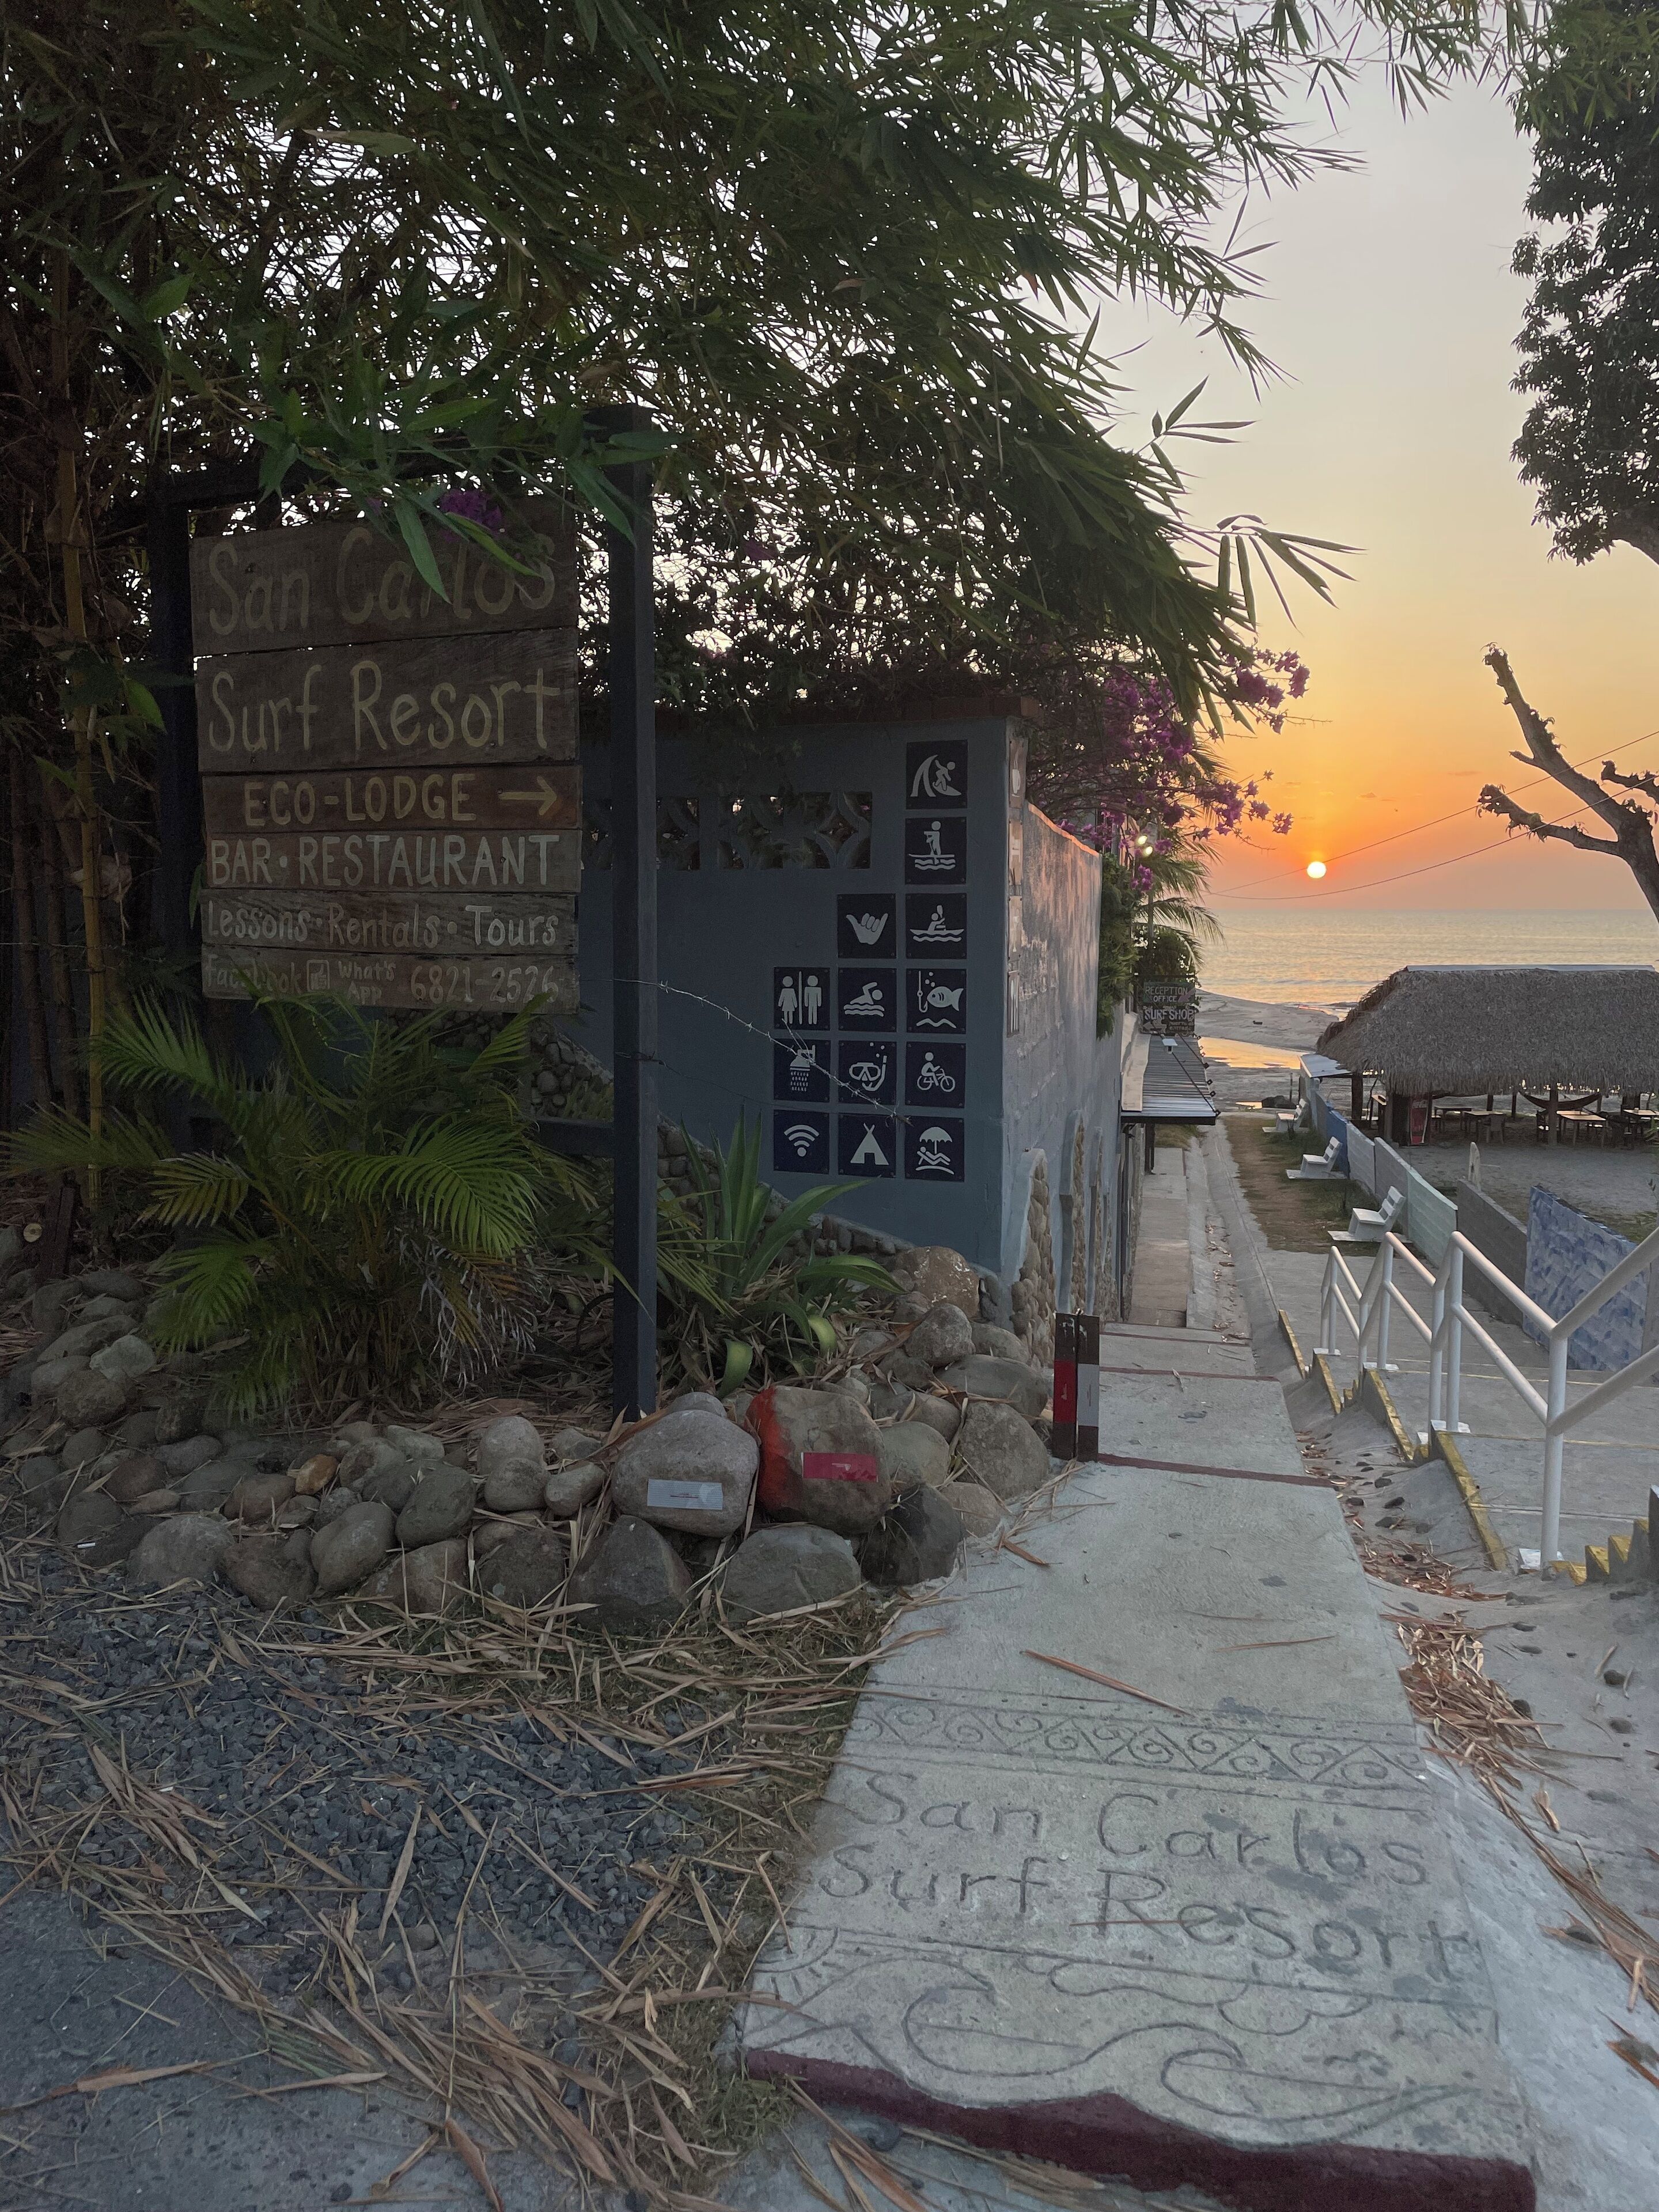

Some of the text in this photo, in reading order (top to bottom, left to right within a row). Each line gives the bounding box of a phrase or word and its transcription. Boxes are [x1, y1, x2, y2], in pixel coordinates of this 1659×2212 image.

[209, 540, 310, 634] San
[209, 660, 560, 751] Surf Resort
[244, 773, 476, 826] ECO-LODGE
[208, 900, 558, 948] Lessons Rentals Tours
[347, 980, 382, 1006] App
[1144, 1008, 1194, 1021] SURF SHOP
[1145, 986, 1188, 995] RECEPTION
[825, 1772, 1427, 1886] San Carlos
[818, 1843, 1470, 1983] Surf Resort
